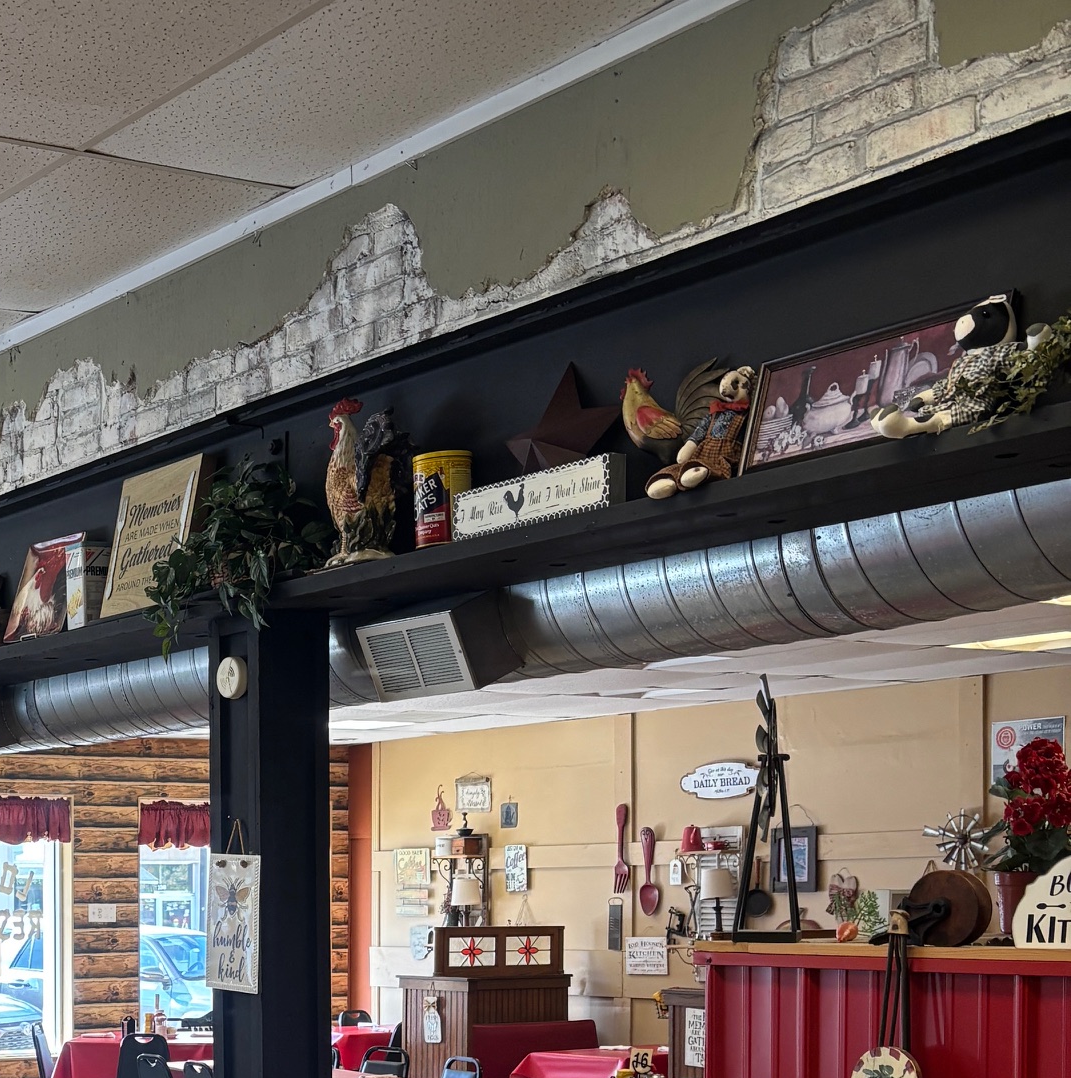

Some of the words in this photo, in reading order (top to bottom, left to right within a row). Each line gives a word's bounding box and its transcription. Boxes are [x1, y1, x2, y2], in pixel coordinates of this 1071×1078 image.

[129, 494, 181, 529] Memories
[469, 506, 484, 522] May
[488, 501, 503, 516] Rise
[527, 491, 541, 506] But
[125, 530, 138, 542] ARE
[139, 523, 158, 538] MADE
[159, 519, 179, 531] WHEN
[119, 540, 174, 580] Gathered
[116, 579, 140, 592] AROUND
[693, 779, 718, 788] DAILY
[720, 776, 750, 787] BREAD
[506, 851, 526, 869] Coffee
[213, 920, 251, 951] humble
[218, 953, 245, 982] kind
[628, 951, 664, 959] KITCHEN
